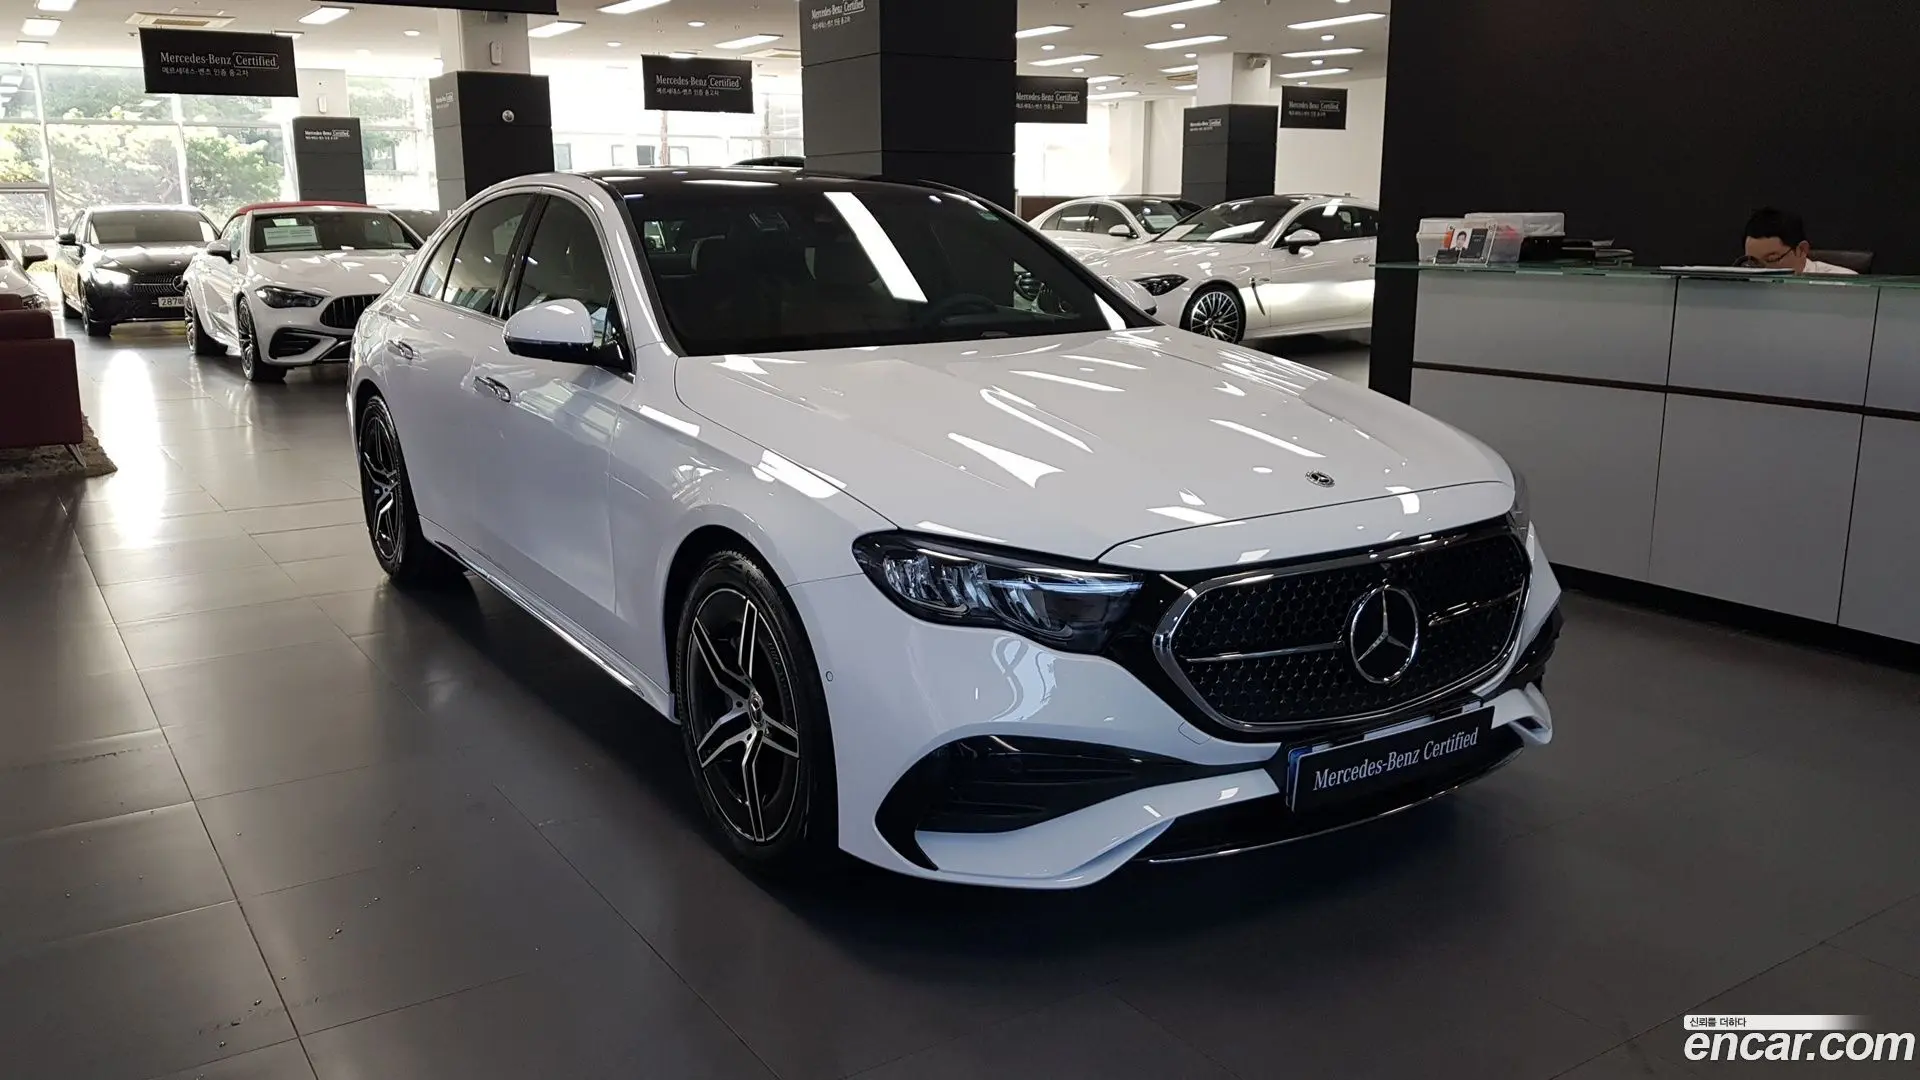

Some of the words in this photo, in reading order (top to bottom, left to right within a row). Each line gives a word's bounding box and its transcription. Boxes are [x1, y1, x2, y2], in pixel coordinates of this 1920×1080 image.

[160, 52, 232, 65] Mercedes-Benz
[235, 54, 276, 67] Certified
[656, 75, 707, 86] Mercedes-Benz
[709, 77, 740, 88] Certified
[1313, 748, 1421, 791] Mercedes-Benz
[1423, 727, 1479, 760] Certified
